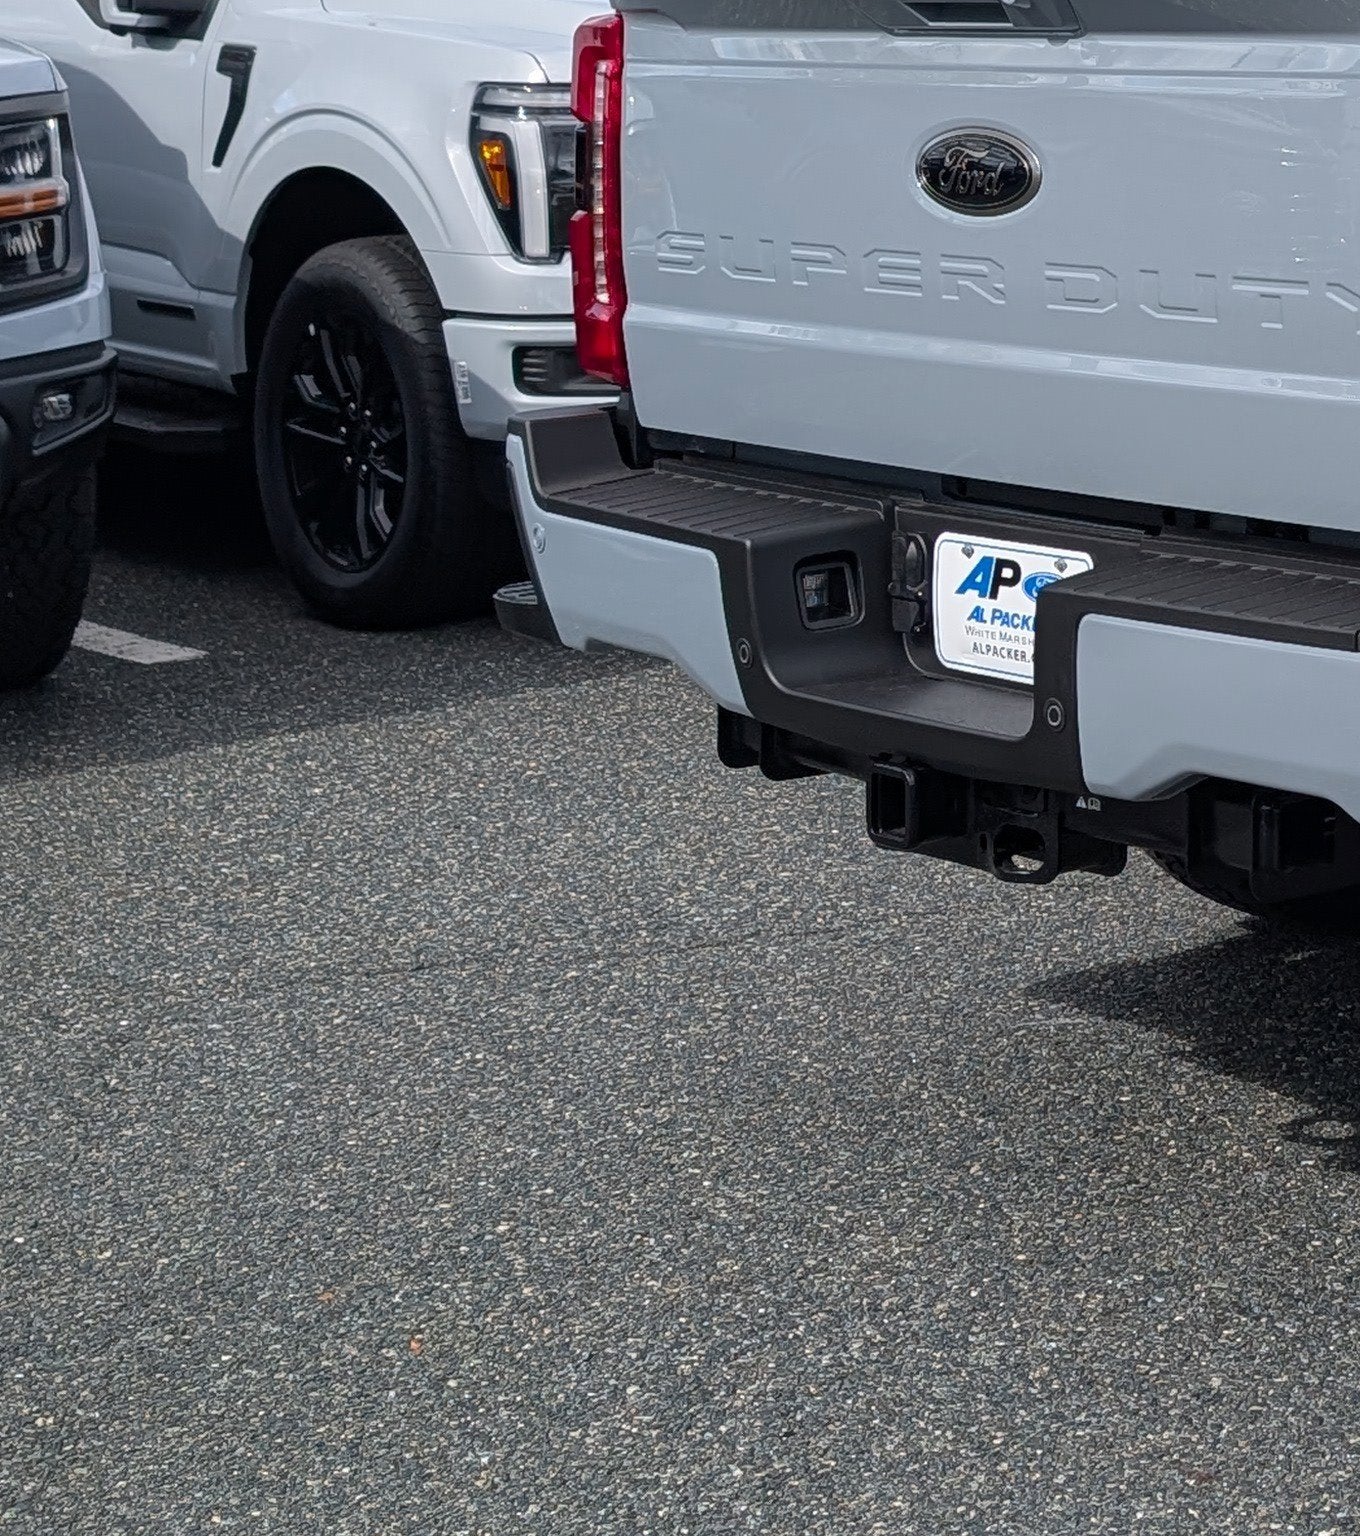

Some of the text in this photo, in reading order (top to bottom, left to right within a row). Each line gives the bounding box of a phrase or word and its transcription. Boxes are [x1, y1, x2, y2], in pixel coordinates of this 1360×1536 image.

[940, 146, 1004, 199] Ford
[656, 230, 1006, 305] SUPER
[954, 555, 1022, 600] AP
[967, 605, 1036, 632] AL PACK
